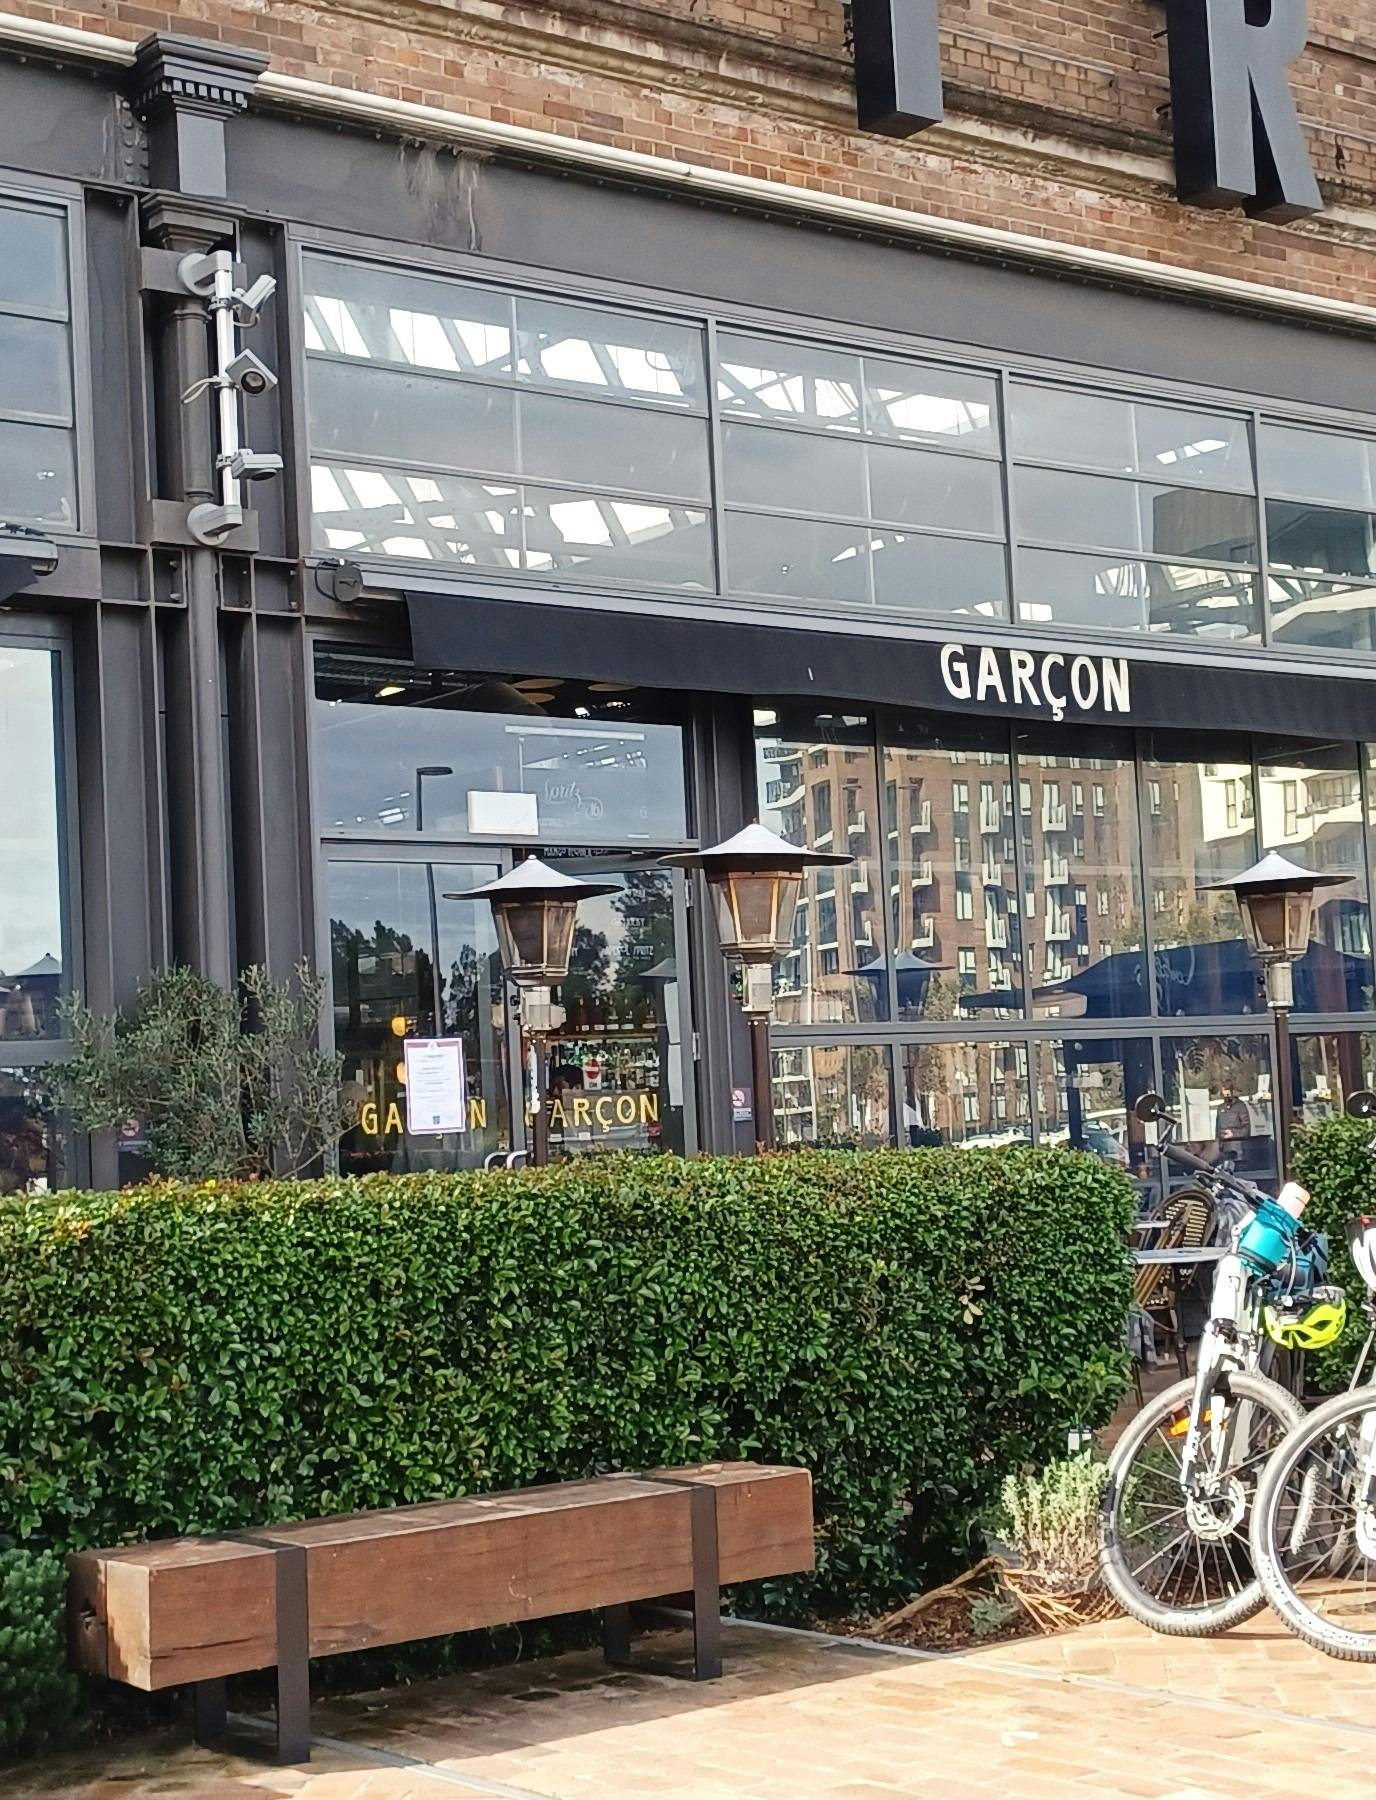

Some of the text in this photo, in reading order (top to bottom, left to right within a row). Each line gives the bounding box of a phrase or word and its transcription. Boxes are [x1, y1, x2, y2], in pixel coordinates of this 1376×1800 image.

[940, 643, 1132, 722] GARÇON
[361, 1098, 487, 1140] GAN
[525, 1093, 659, 1133] ARÇON
